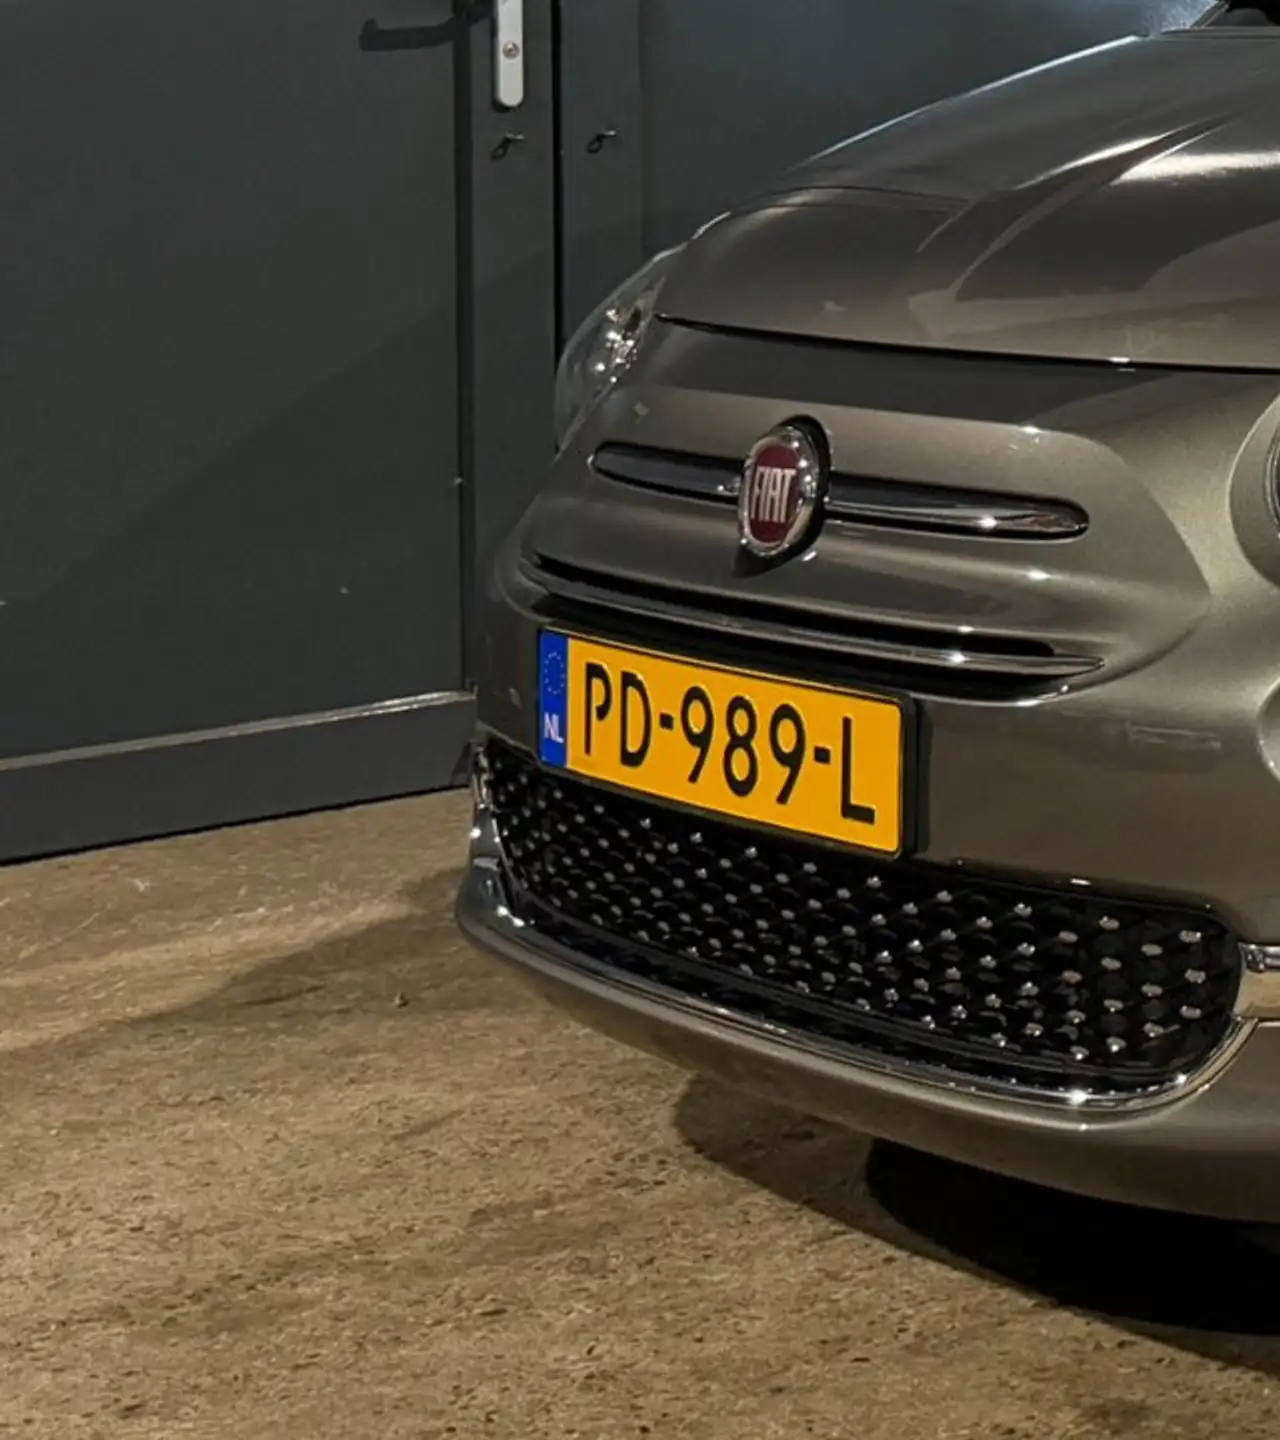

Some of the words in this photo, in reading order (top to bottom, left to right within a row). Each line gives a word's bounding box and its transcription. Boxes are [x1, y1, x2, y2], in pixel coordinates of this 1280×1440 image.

[751, 465, 797, 523] FIAT
[544, 712, 564, 743] NL
[584, 662, 876, 825] PD-989-L
